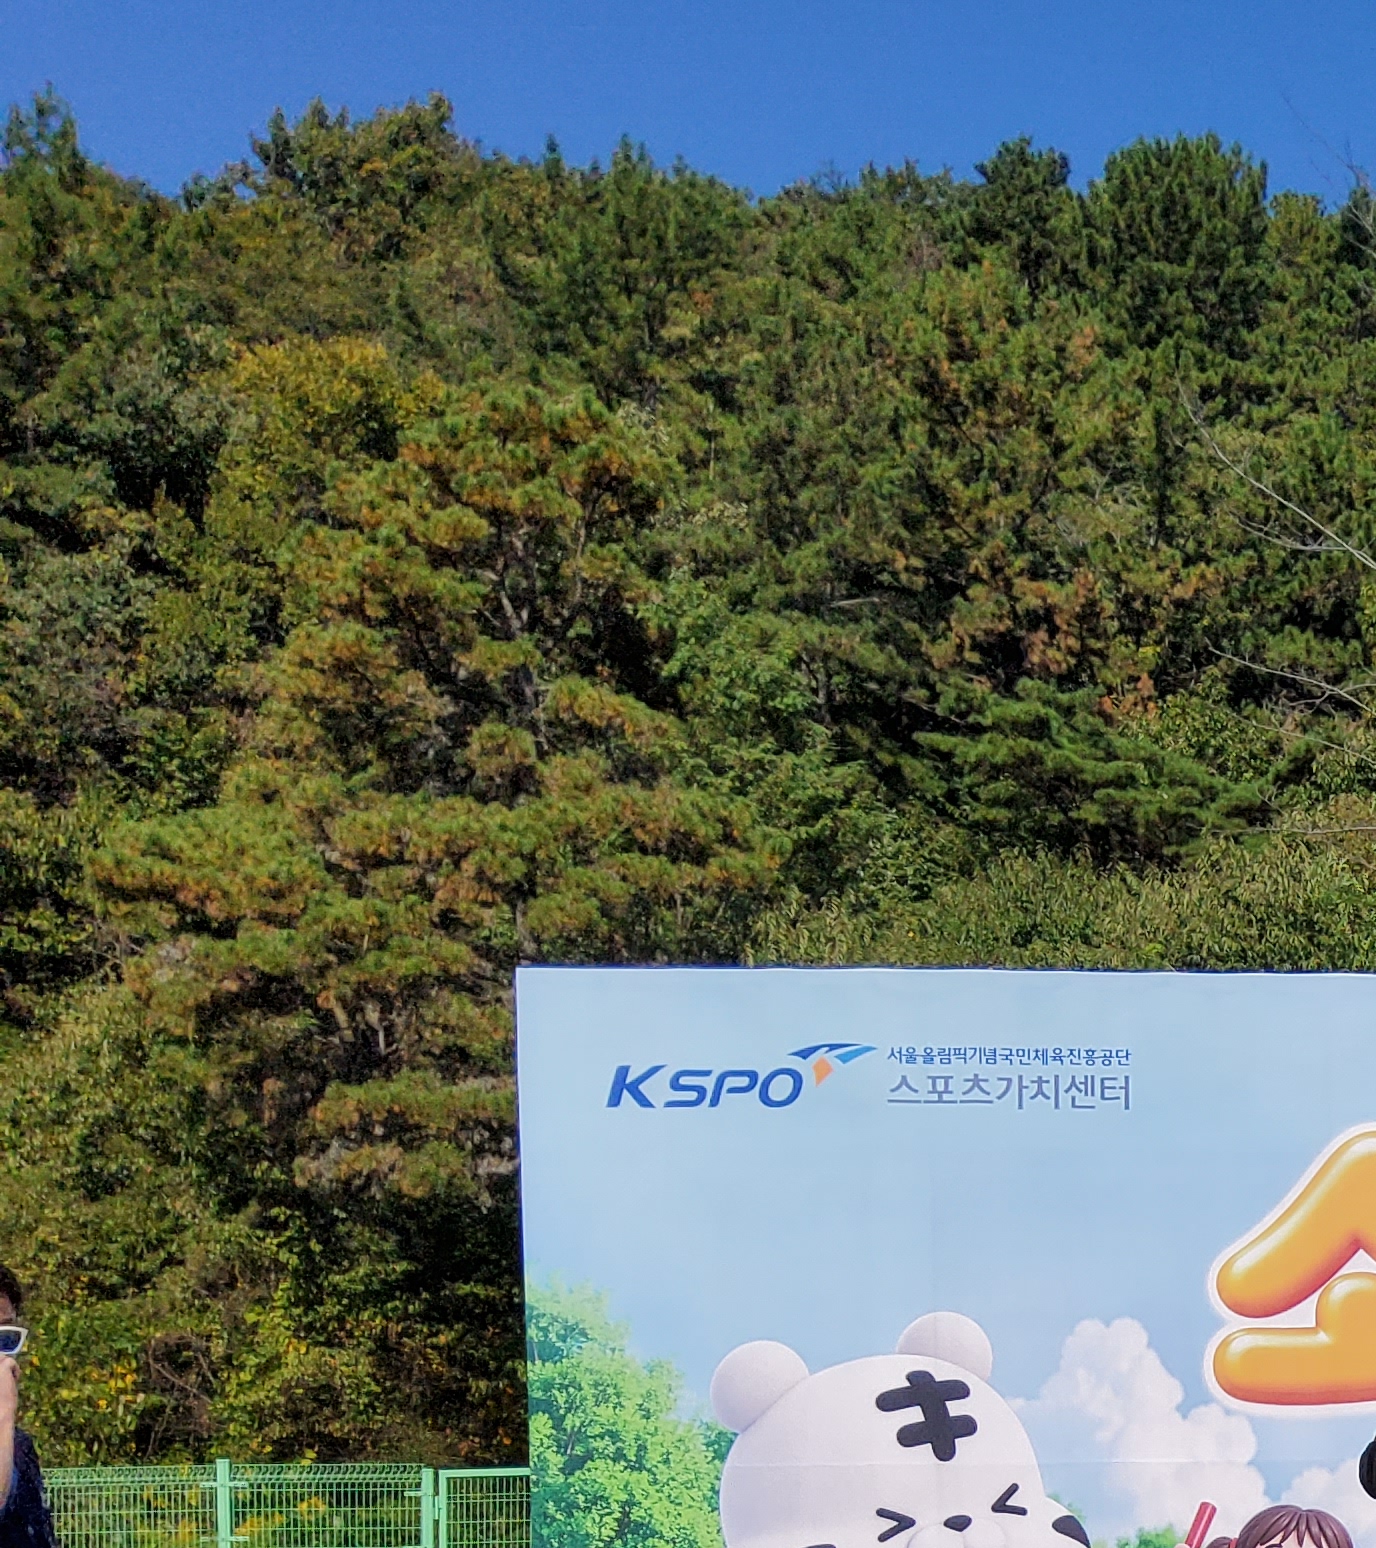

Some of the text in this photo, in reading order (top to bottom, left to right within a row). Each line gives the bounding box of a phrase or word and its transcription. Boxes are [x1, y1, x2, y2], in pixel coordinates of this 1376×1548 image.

[887, 1046, 1132, 1067] 서울올림픽기념국민체육진흥공단
[605, 1064, 804, 1109] KSPO
[887, 1074, 1131, 1111] 스포츠가치센터
